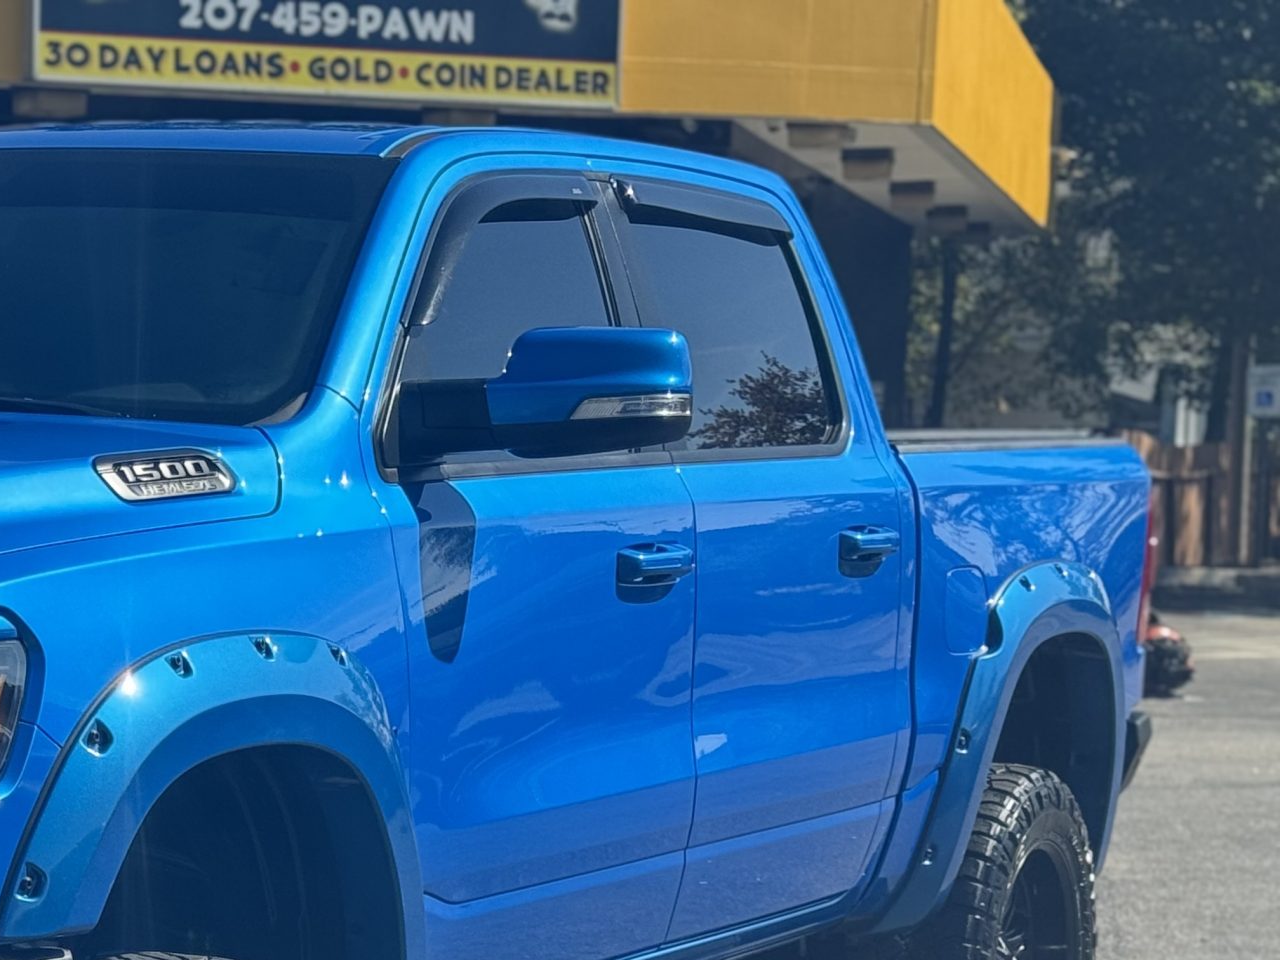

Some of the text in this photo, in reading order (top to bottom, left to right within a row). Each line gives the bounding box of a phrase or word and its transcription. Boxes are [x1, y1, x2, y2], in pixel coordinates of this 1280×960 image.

[45, 40, 610, 94] 30 DAY LOANS GOLD COIN DEALER
[120, 459, 211, 483] 1500
